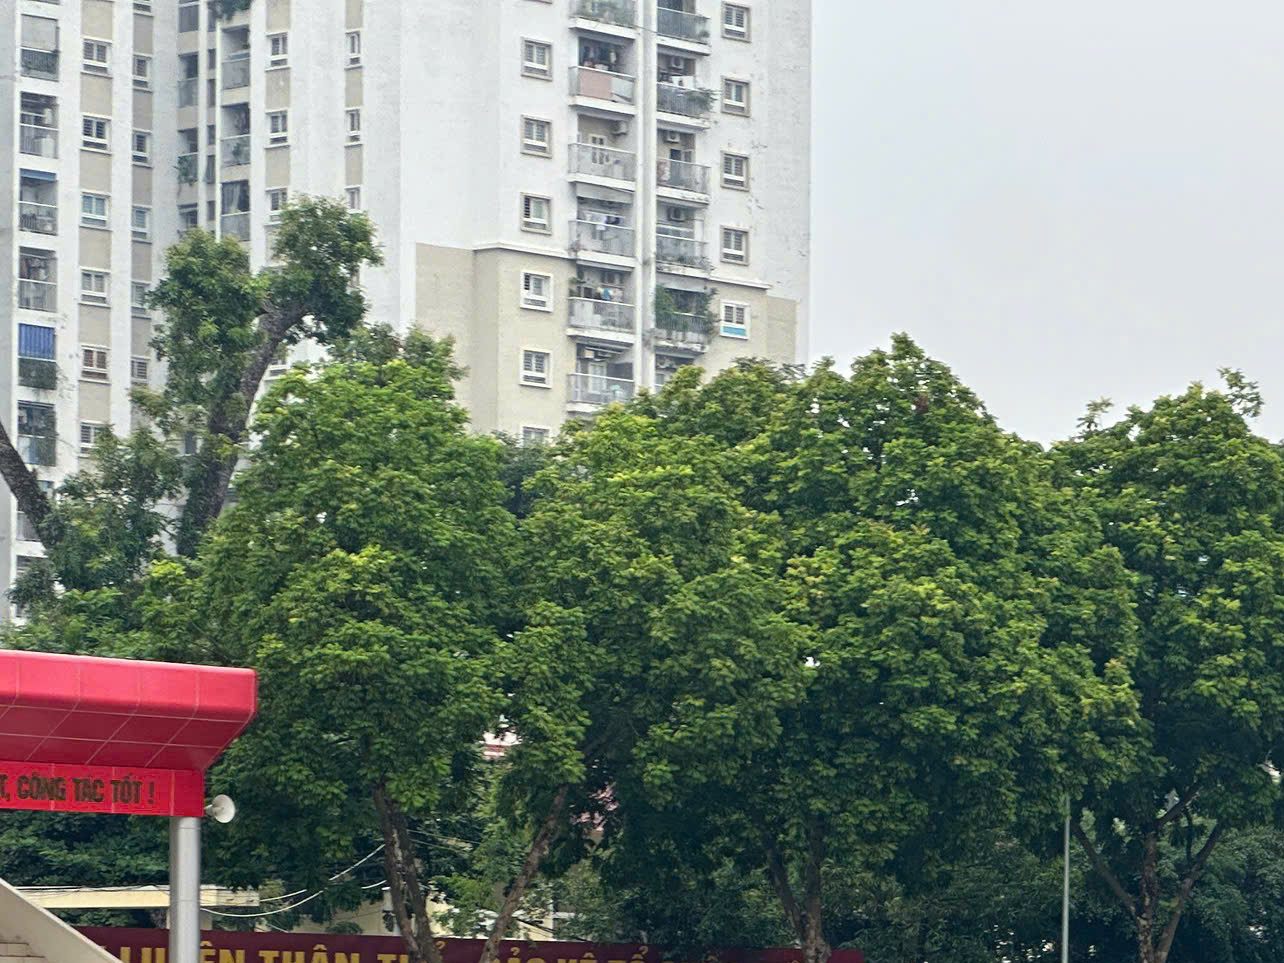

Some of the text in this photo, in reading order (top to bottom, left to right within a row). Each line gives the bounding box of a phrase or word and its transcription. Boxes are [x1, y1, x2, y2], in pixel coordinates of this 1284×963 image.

[17, 771, 66, 800] CÔNG
[72, 774, 104, 803] TÁC
[110, 772, 143, 804] TỐT
